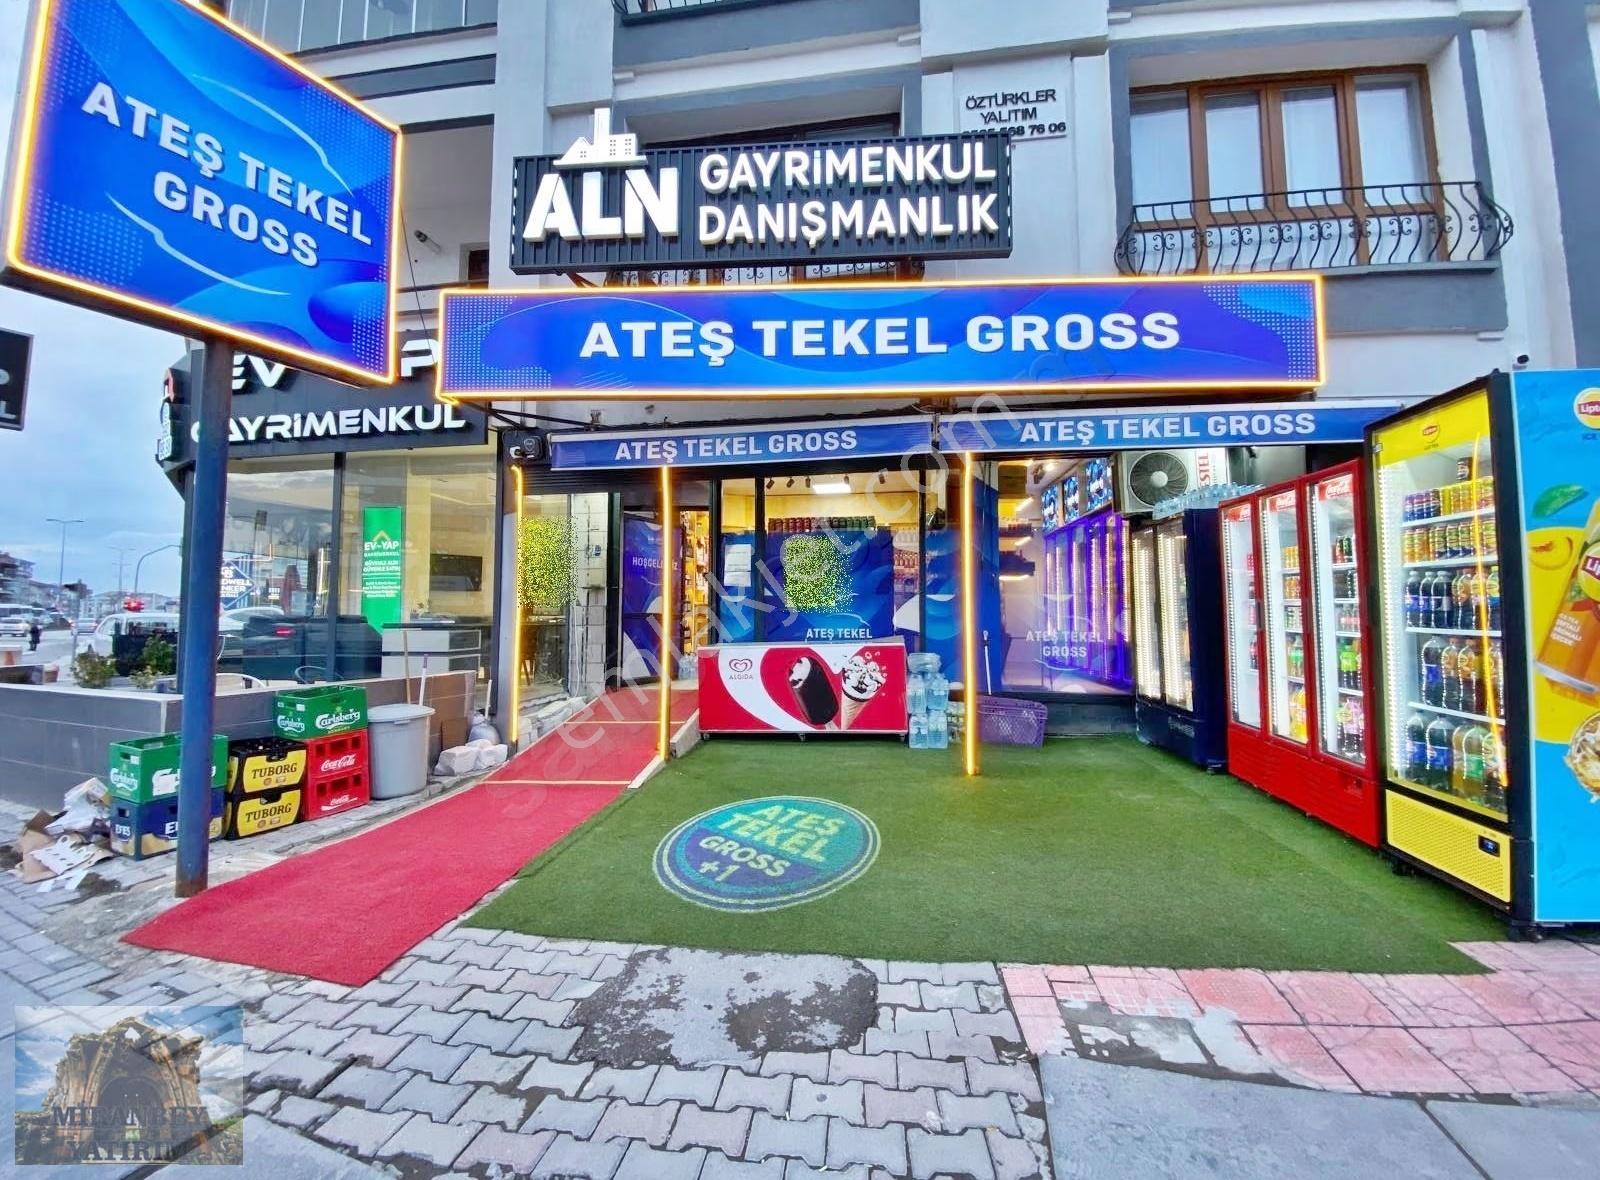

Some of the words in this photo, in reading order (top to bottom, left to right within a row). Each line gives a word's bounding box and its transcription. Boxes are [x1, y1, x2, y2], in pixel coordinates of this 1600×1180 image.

[965, 88, 1057, 110] ÖZTÜRKLER
[980, 106, 1037, 125] YALITIM
[1028, 123, 1046, 136] 76
[1048, 121, 1067, 134] 06
[82, 81, 225, 178] ATEŞ
[239, 152, 372, 246] TEKEL
[699, 141, 997, 195] GAYRİMENKUL
[153, 170, 319, 268] GROSS
[523, 166, 679, 241] ALN
[698, 192, 1000, 248] DANIŞMANLIK
[580, 320, 735, 367] ATEŞ
[752, 316, 948, 357] TEKEL
[965, 311, 1181, 354] GROSS
[191, 403, 466, 442] AYRİMENKUL
[1020, 419, 1095, 445] ATEŞ
[1102, 415, 1201, 440] TEKEL
[1207, 412, 1316, 436] GROSS
[615, 439, 678, 464] ATEŞ
[683, 434, 762, 459] TEKEL
[768, 430, 858, 453] GROSS
[221, 578, 253, 586] DWELL
[806, 628, 834, 641] ATEŞ
[836, 628, 873, 639] TEKEL
[1061, 631, 1104, 643] TEKEL
[1042, 645, 1087, 658] GROSS
[315, 708, 361, 730] Carlsberg
[251, 762, 297, 779] TUBORG
[245, 802, 292, 822] TUBORG
[718, 812, 828, 863] TEKEL
[698, 835, 791, 877] GROSS
